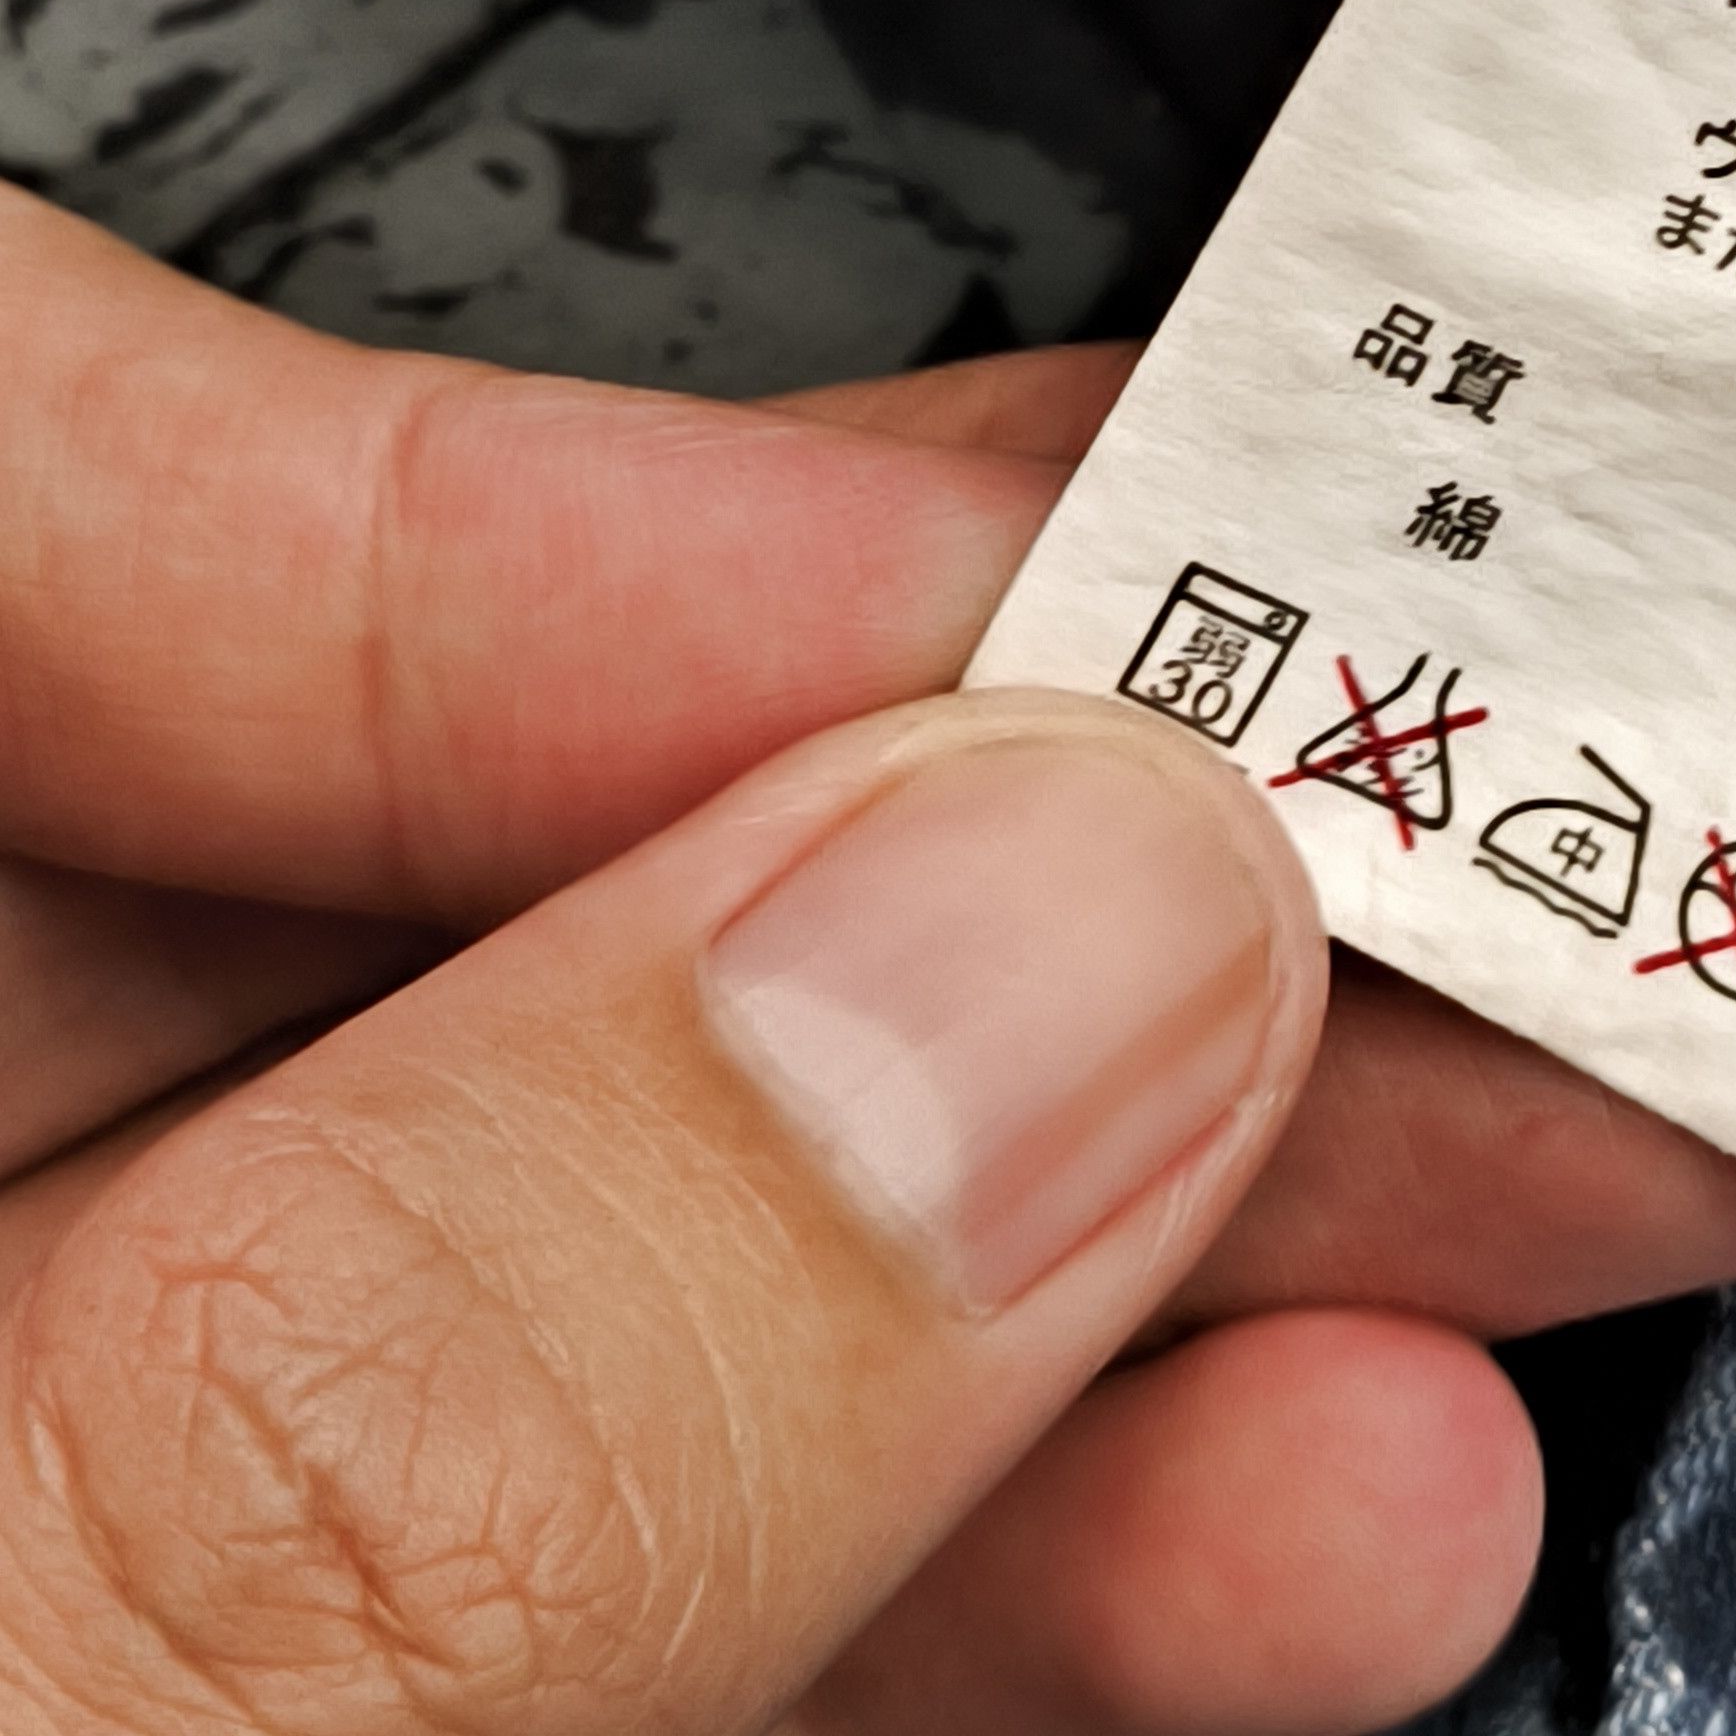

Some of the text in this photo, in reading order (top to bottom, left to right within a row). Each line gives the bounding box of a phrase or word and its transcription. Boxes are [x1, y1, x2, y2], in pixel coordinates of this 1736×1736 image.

[1351, 302, 1527, 427] 品質
[1403, 480, 1503, 562] 綿
[1148, 659, 1233, 726] 30
[1550, 826, 1605, 876] 中
